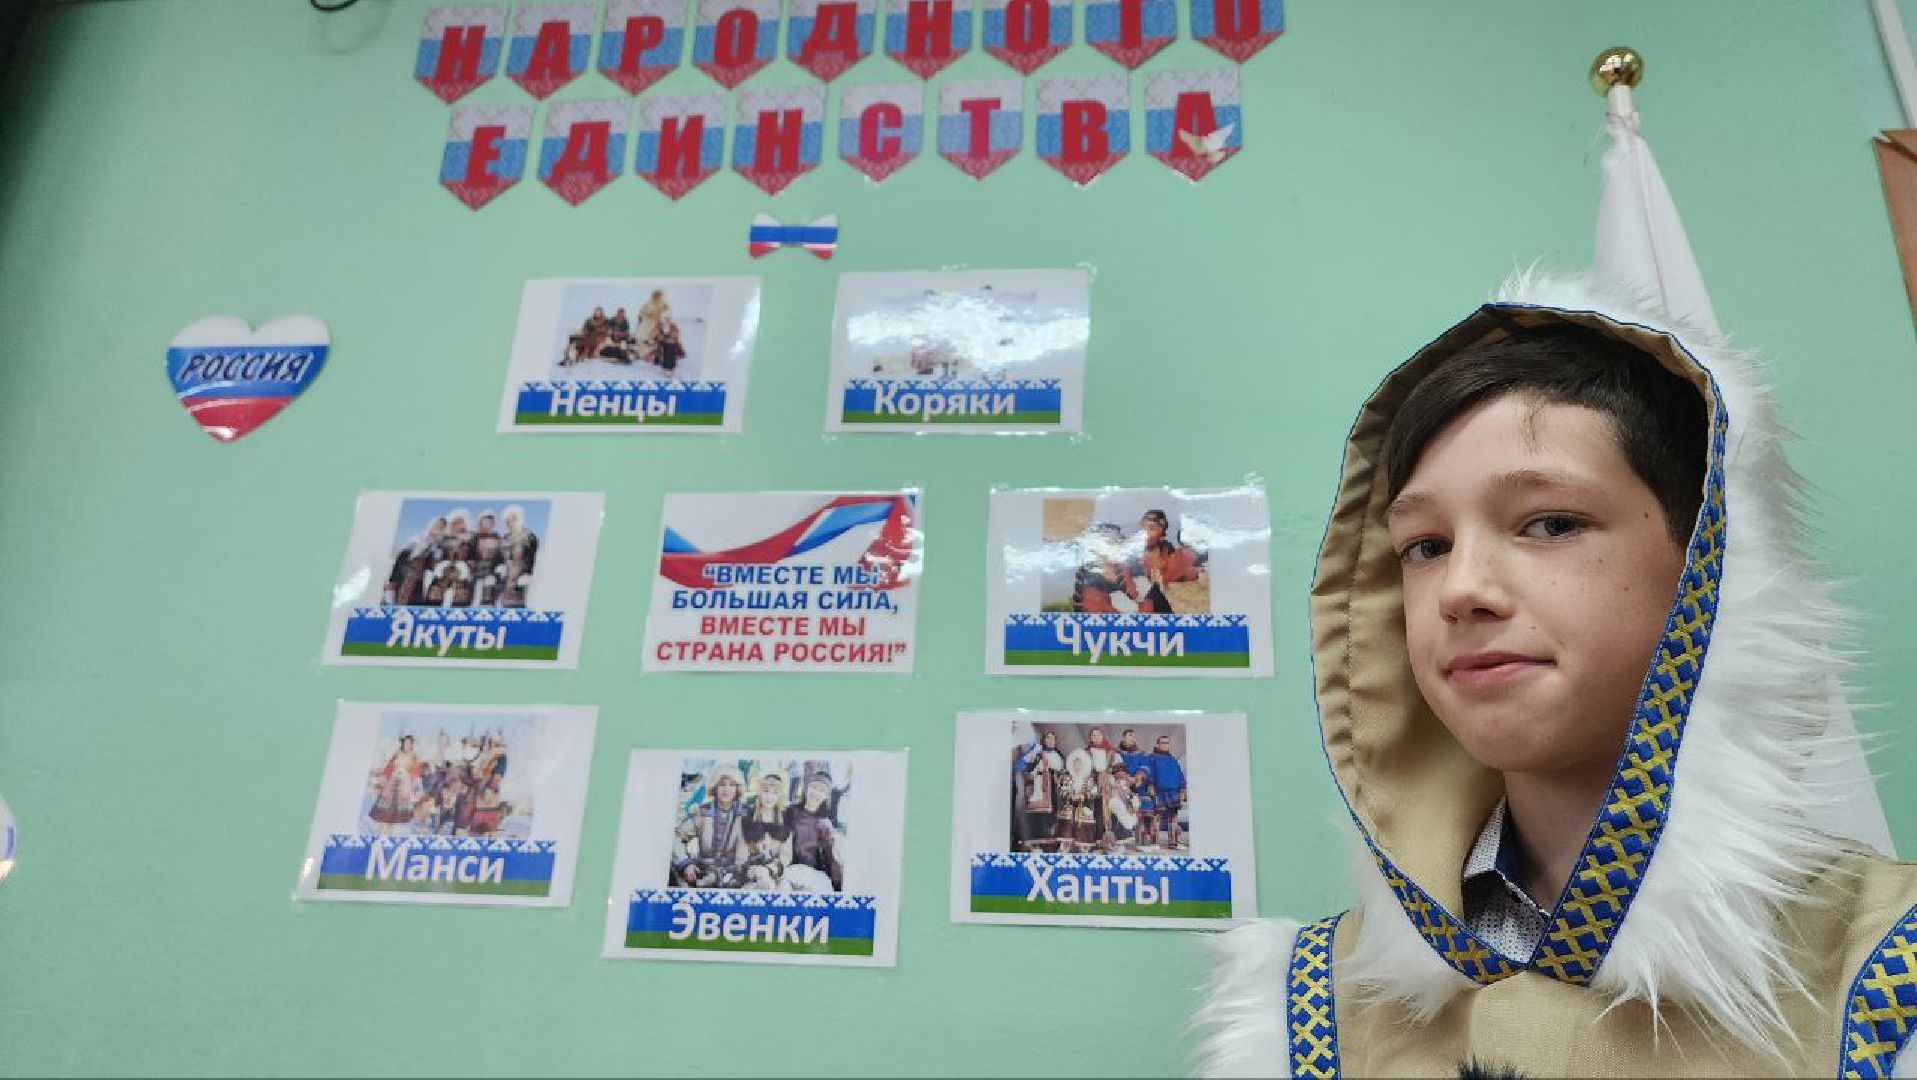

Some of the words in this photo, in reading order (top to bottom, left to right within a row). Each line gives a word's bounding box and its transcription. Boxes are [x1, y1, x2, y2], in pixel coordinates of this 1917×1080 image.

[434, 0, 1262, 82] НАРОДНОГО
[465, 91, 1218, 188] ЕДИНСТВА
[180, 352, 313, 383] РОССИЯ
[550, 387, 677, 422] Ненцы
[874, 383, 1015, 422] Коряки
[672, 590, 808, 609] БОЛЬШАЯ
[818, 591, 898, 614] СИЛА,
[386, 610, 507, 657] Якуты
[701, 617, 809, 636] ВМЕСТЕ
[819, 618, 865, 636] МЫ
[1055, 617, 1184, 664] Чукчи
[656, 641, 763, 662] СТРАНА
[365, 843, 504, 884] Манси
[1026, 863, 1169, 905] Ханты
[668, 902, 830, 945] Эвенки
